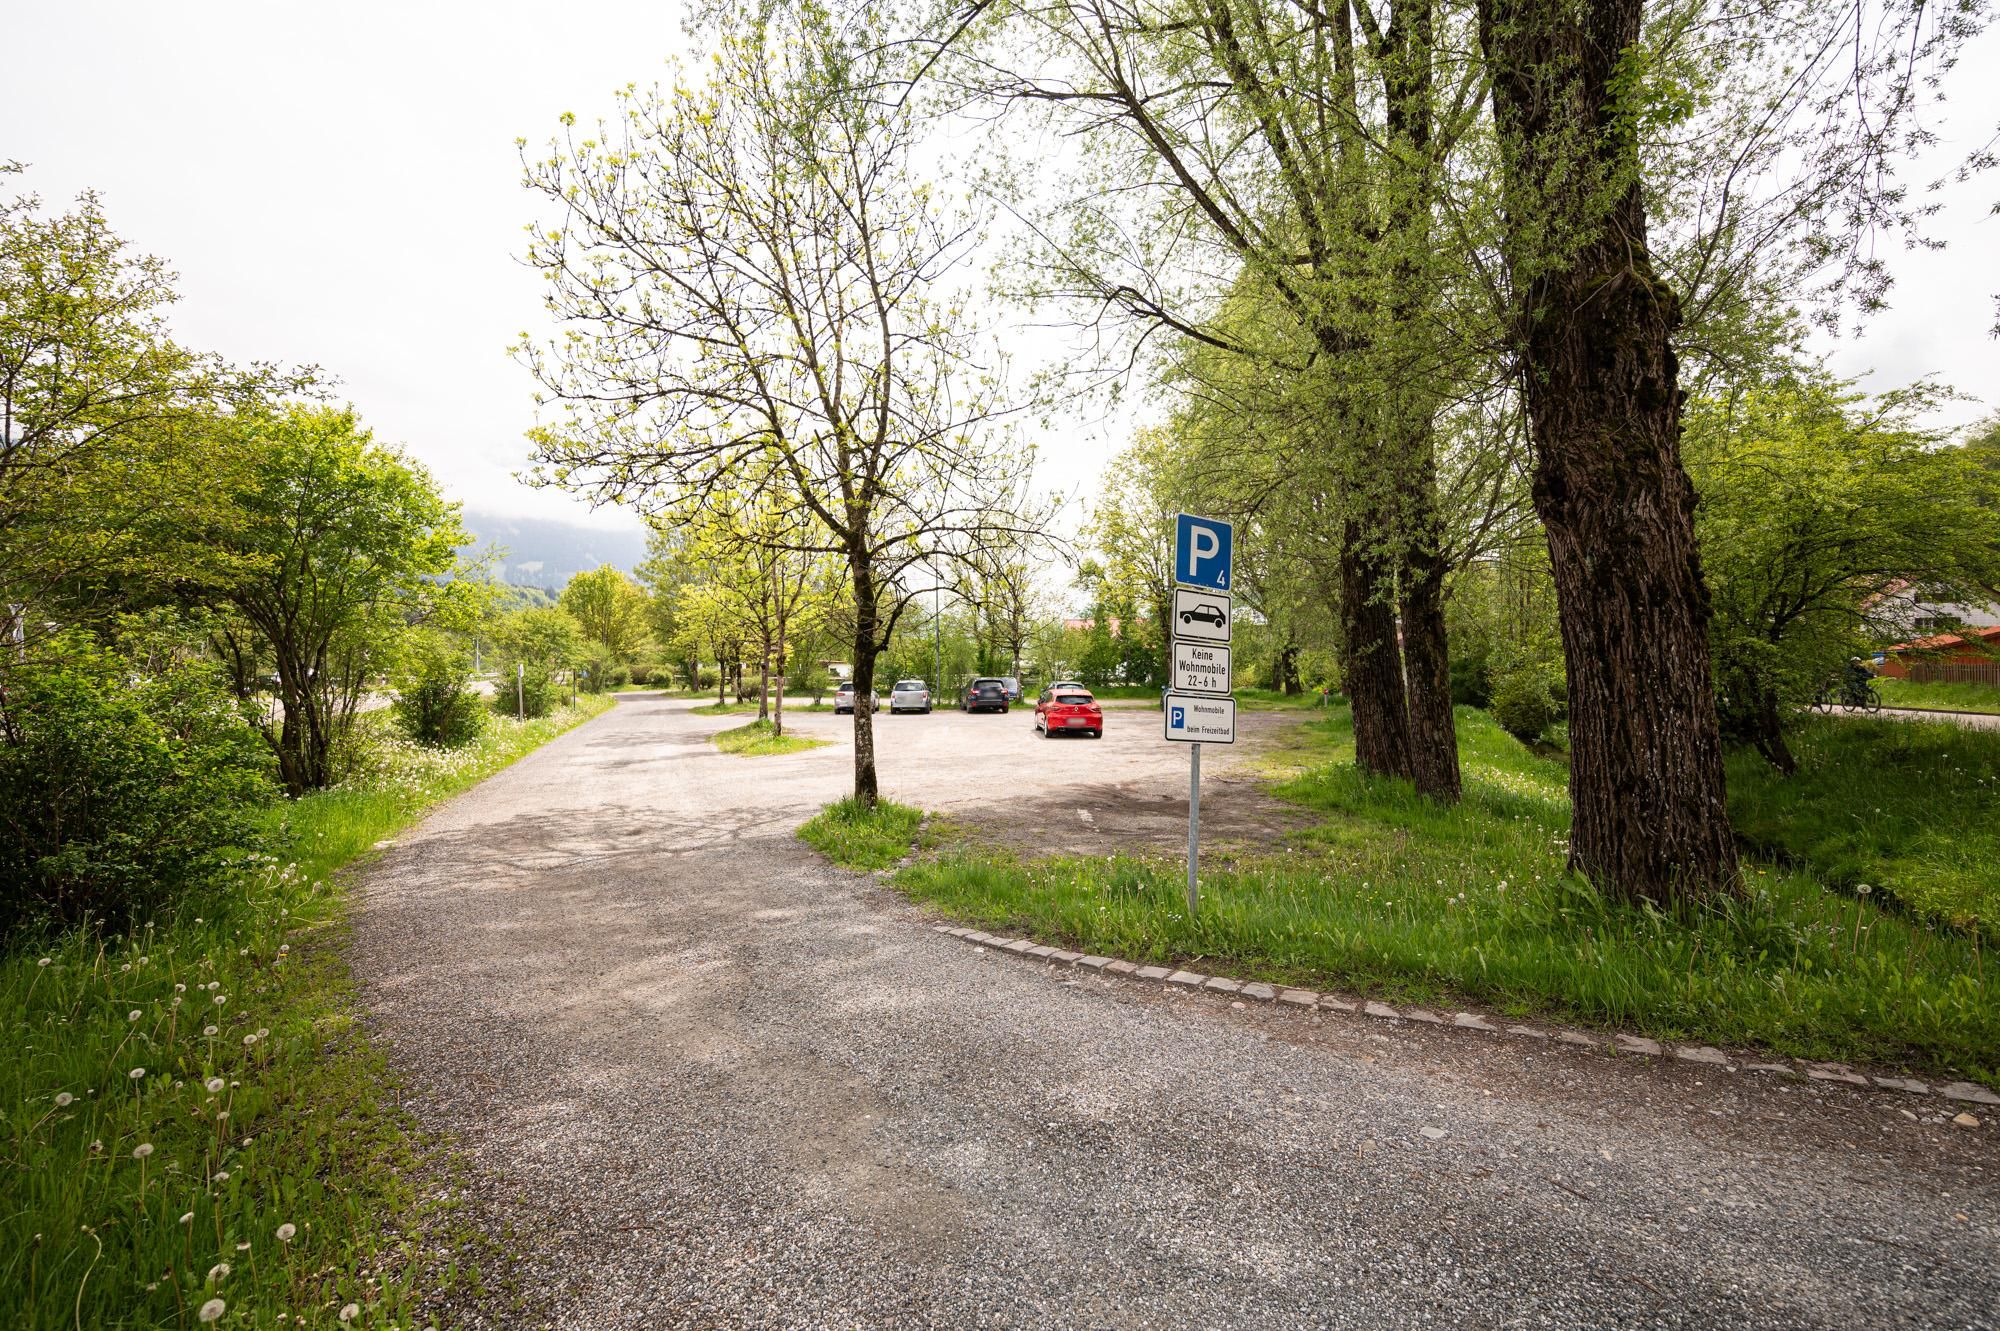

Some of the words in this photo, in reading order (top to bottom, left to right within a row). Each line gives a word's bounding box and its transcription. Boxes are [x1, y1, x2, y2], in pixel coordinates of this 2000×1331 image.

[1189, 525, 1219, 576] P
[1217, 570, 1225, 586] 4
[1192, 648, 1213, 661] Keine
[1179, 660, 1225, 675] Wohnmobile
[1212, 676, 1217, 688] h
[1194, 705, 1225, 714] Wohnmobile
[1173, 710, 1182, 726] P
[1187, 725, 1200, 733] beim
[1201, 726, 1230, 735] Freizeitbad
